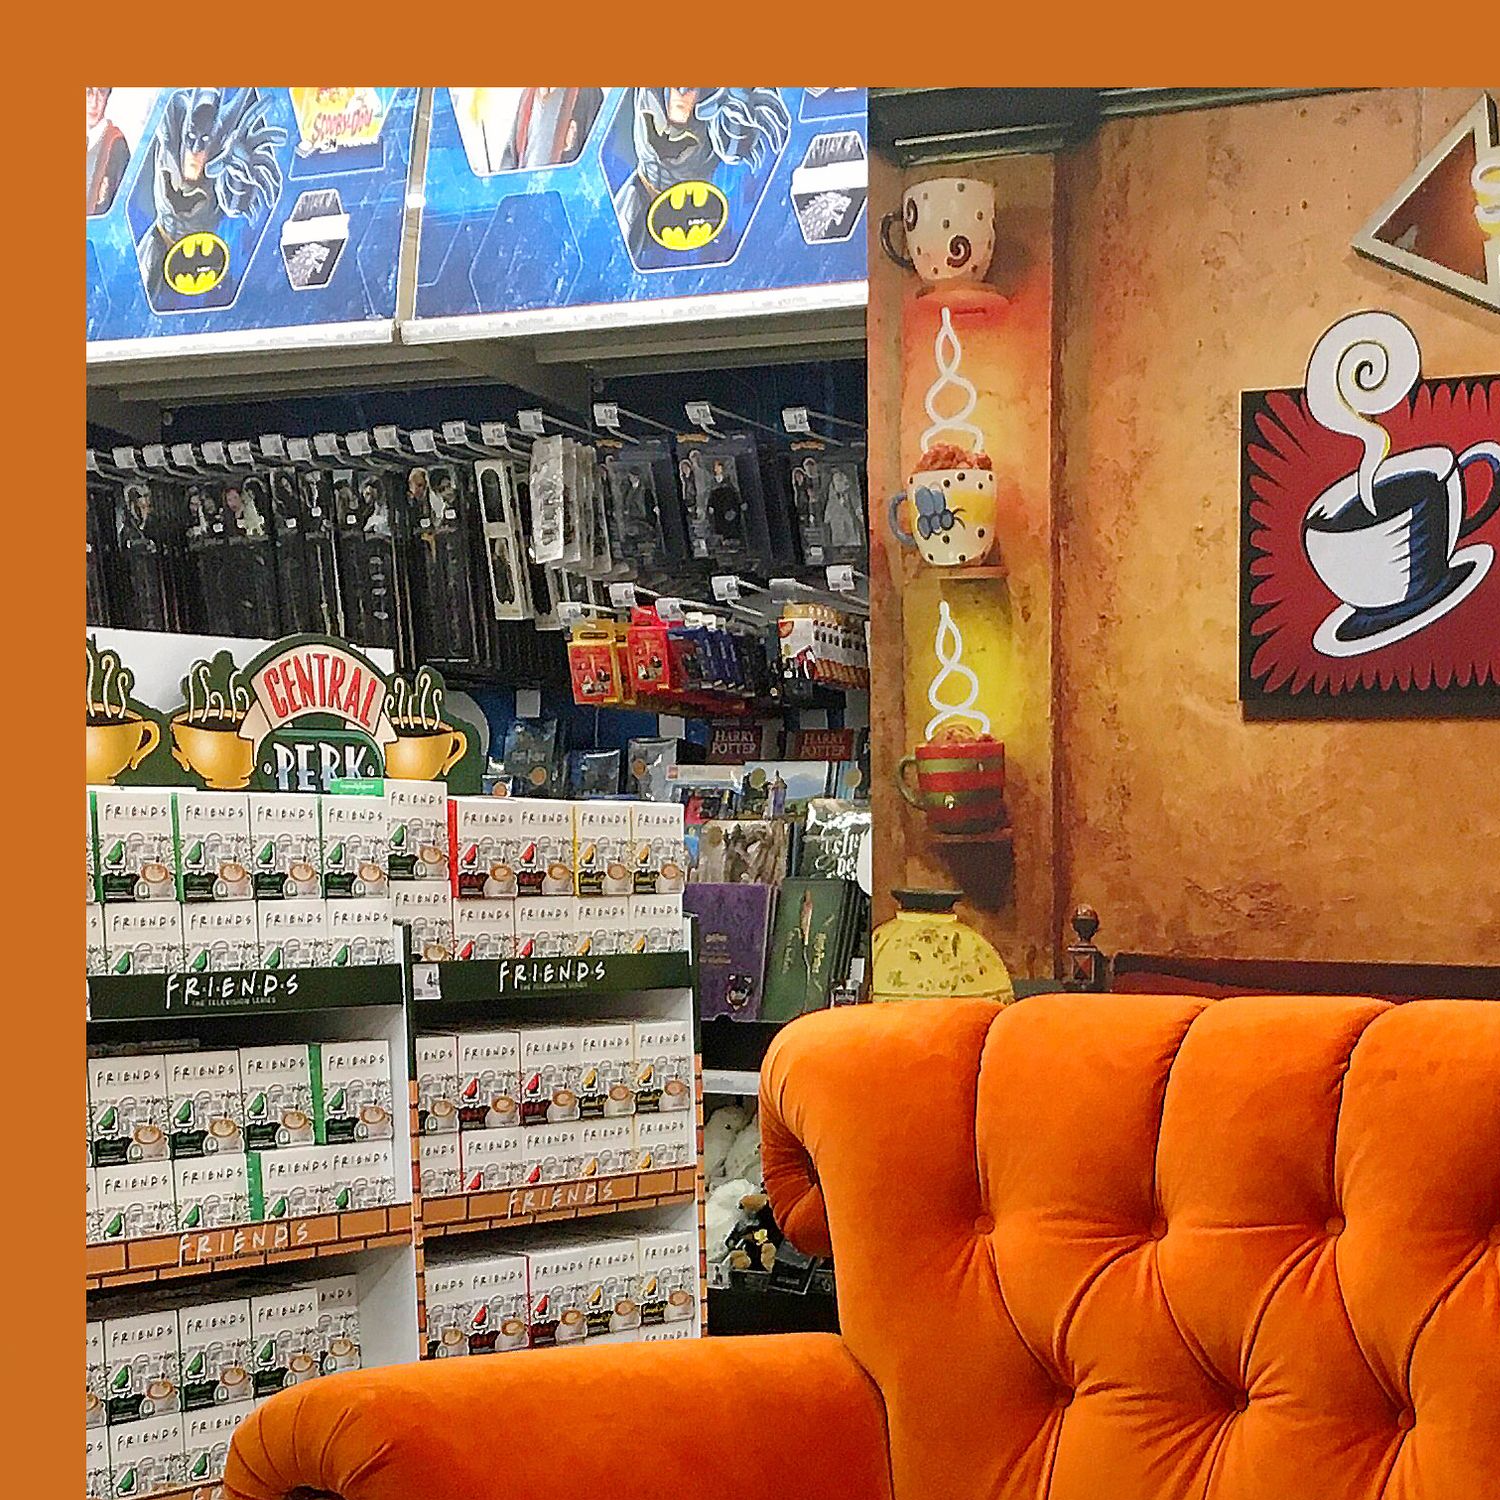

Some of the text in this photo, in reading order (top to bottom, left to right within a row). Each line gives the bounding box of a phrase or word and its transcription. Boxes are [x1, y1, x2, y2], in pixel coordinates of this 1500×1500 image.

[264, 652, 378, 726] CENTRAL
[715, 730, 754, 742] HARRY
[711, 742, 756, 755] POTTER
[273, 741, 367, 791] PERK
[391, 790, 443, 807] FRIENDS
[105, 803, 167, 819] FRIENDS
[185, 804, 245, 820] FRIENDS
[257, 805, 314, 821] FRIENDS
[329, 807, 383, 822] FRIENDS
[464, 811, 513, 826] FRIENDS
[521, 810, 569, 824] FRIENDS
[582, 811, 628, 825] FRIENDS
[638, 812, 682, 826] FRIENDS
[395, 891, 448, 907] FRIENDS
[333, 910, 389, 926] FRIENDS
[460, 906, 510, 922] FRIENDS
[520, 905, 569, 920] FRIENDS
[578, 905, 625, 920] FRIENDS
[634, 904, 679, 918] FRIENDS
[113, 914, 177, 931] FRIENDS
[190, 913, 252, 930] FRIENDS
[266, 911, 323, 928] FRIENDS
[525, 1040, 575, 1054] FRIENDS
[582, 1035, 630, 1049] FRIENDS
[640, 1032, 686, 1046] FRIENDS
[420, 1048, 453, 1060] IENDS
[464, 1045, 515, 1061] FRIENDS
[247, 1057, 305, 1075] FRIENDS
[328, 1054, 385, 1071] FRIENDS
[97, 1068, 160, 1087] FRIENDS
[173, 1064, 234, 1082] FRIENDS
[583, 1125, 630, 1141] FRIENDS
[640, 1121, 685, 1135] FRIENDS
[468, 1138, 518, 1153] FRIENDS
[527, 1131, 575, 1148] FRIENDS
[421, 1143, 455, 1156] IENDS
[269, 1160, 328, 1179] FRIENDS
[332, 1151, 388, 1172] FRIENDS
[104, 1174, 168, 1195] FRIENDS
[182, 1167, 243, 1187] FRIENDS
[508, 1180, 613, 1219] FRIENDS
[178, 1222, 309, 1268] FRIENDS
[644, 1243, 690, 1260] FRIENDS
[588, 1251, 635, 1270] FRIENDS
[472, 1269, 523, 1286] FRIENDS
[535, 1260, 584, 1279] FRIENDS
[429, 1278, 464, 1293] IENDS
[320, 1287, 353, 1302] ENDS
[258, 1301, 314, 1323] FRIENDS
[186, 1313, 246, 1335] FRIENDS
[111, 1323, 174, 1345] FRIENDS
[190, 1414, 243, 1436] FRIEND
[117, 1427, 179, 1451] FRIENDS
